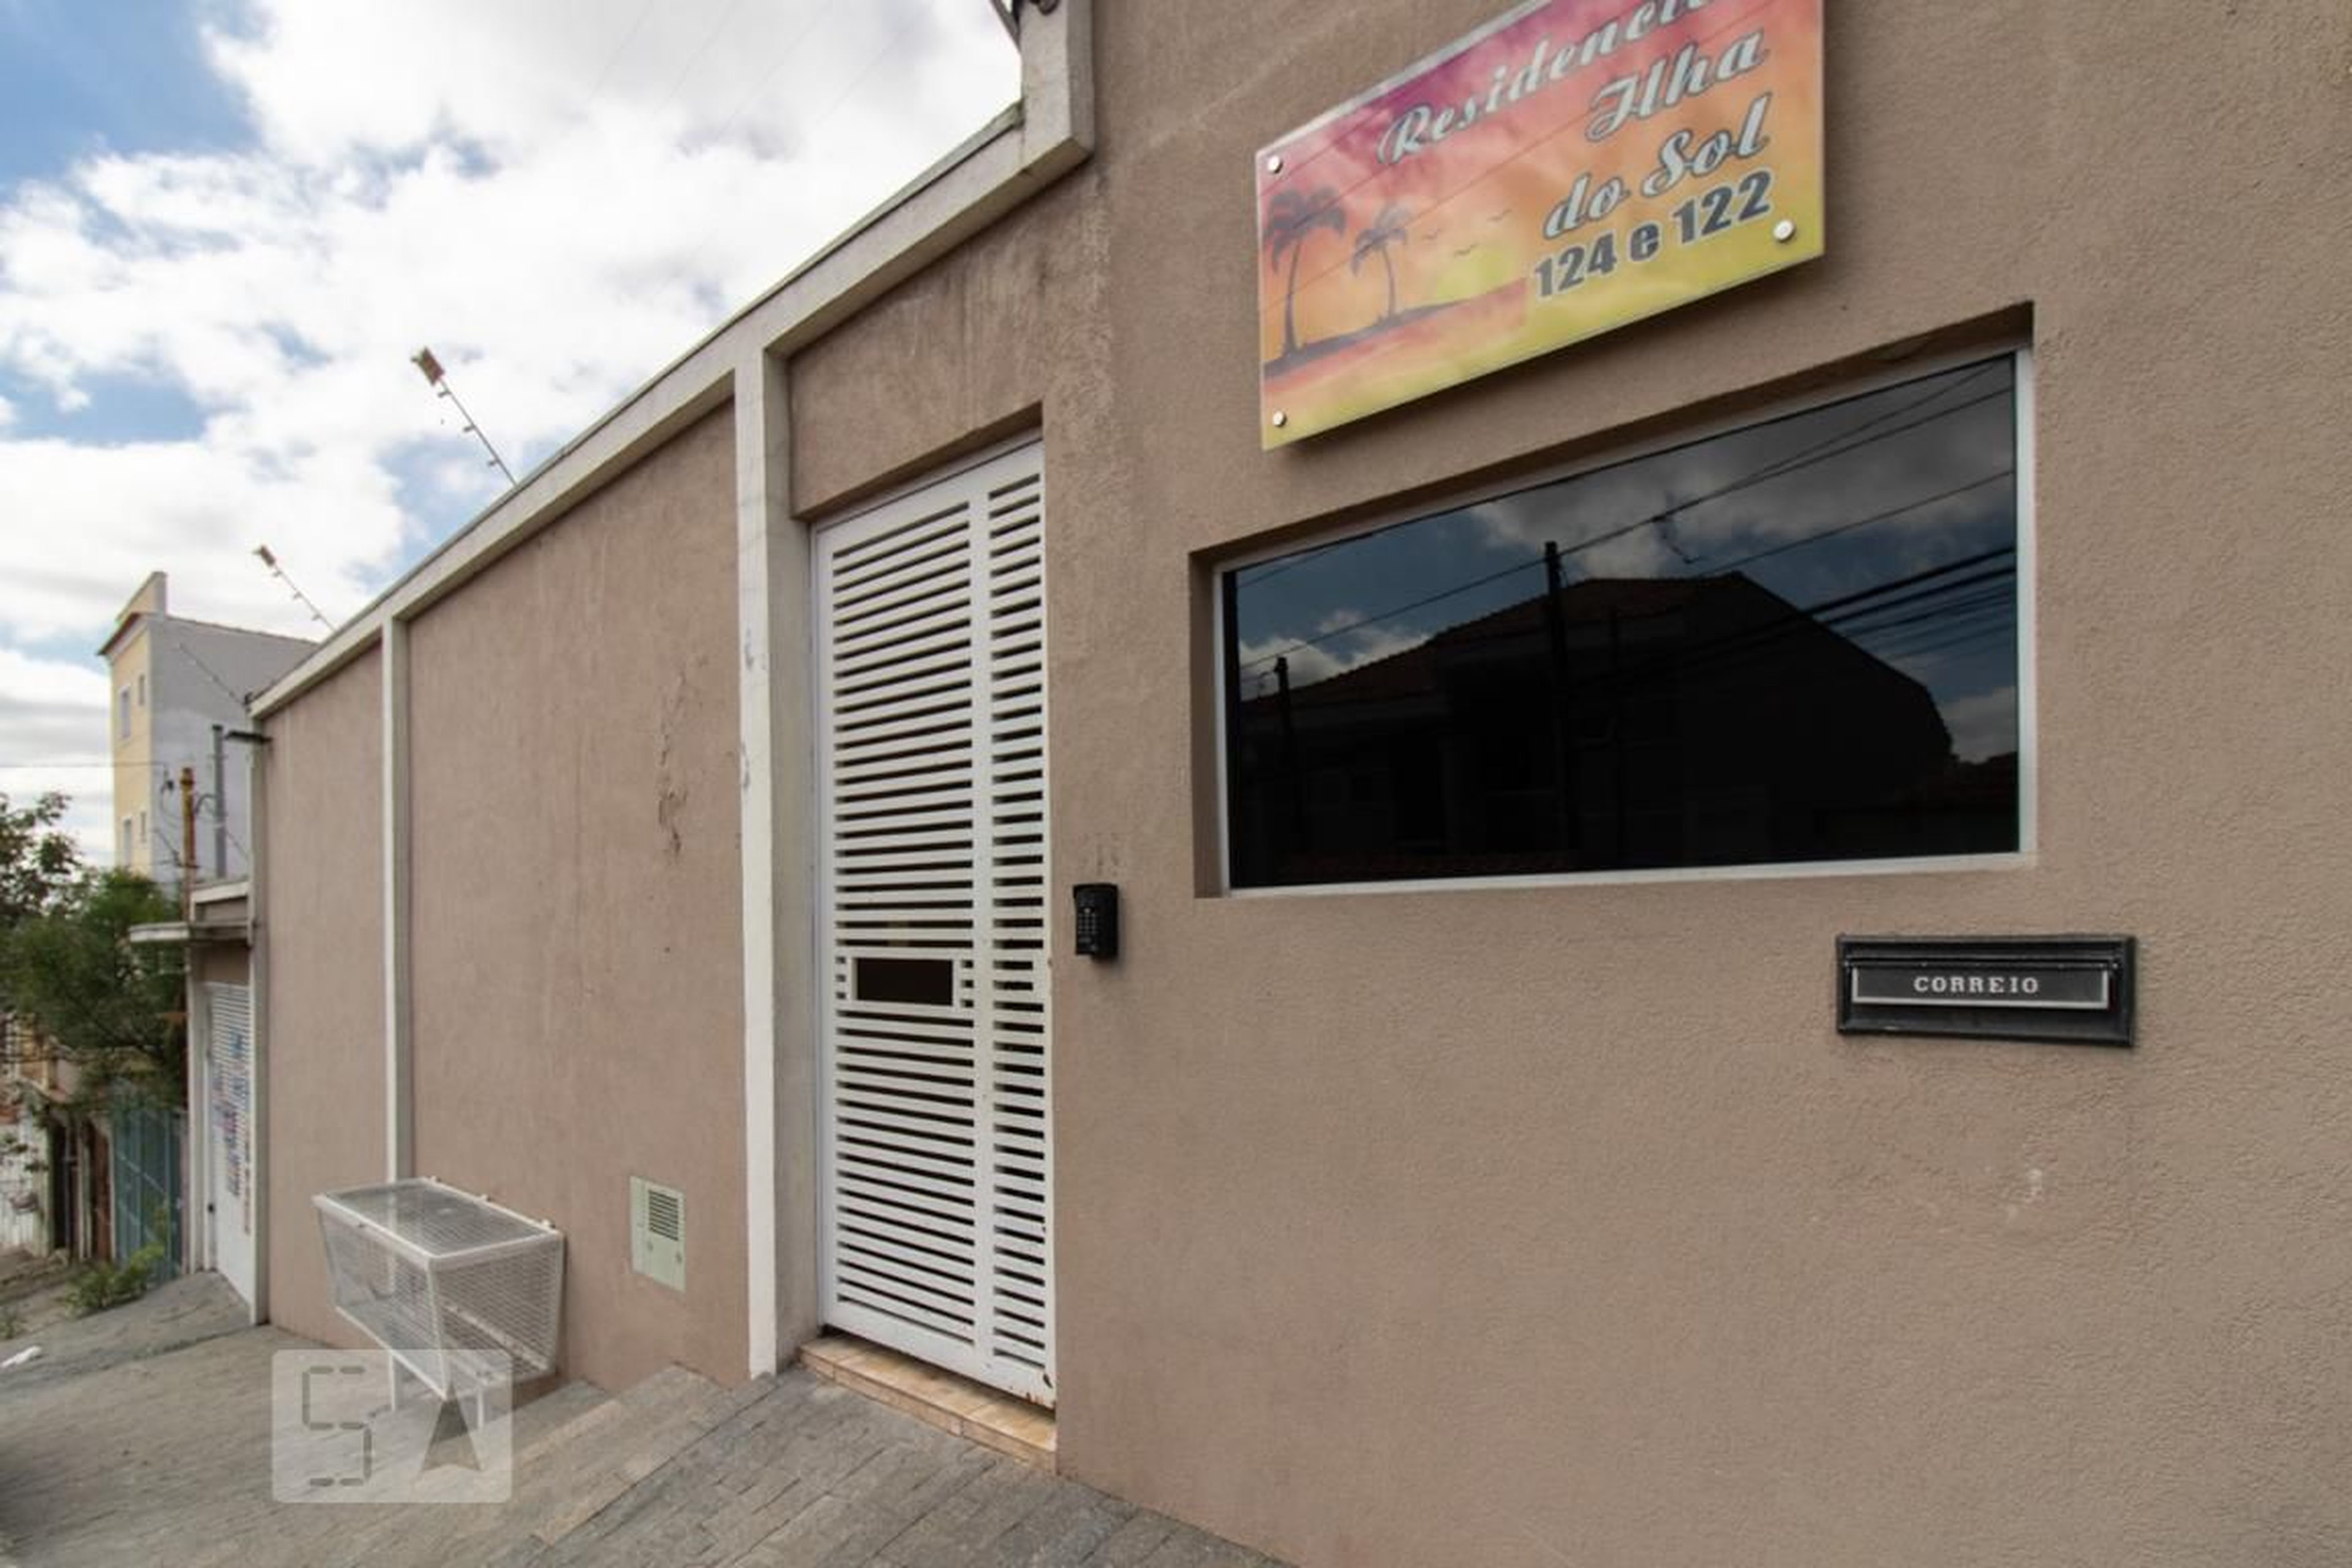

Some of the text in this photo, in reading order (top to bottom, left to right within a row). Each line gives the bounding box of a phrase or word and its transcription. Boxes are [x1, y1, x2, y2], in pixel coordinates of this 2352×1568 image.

[1586, 28, 1770, 142] Ilha
[1544, 92, 1773, 239] do Sol
[1534, 170, 1772, 298] 124 e 122
[1913, 976, 2039, 994] CORREIO
